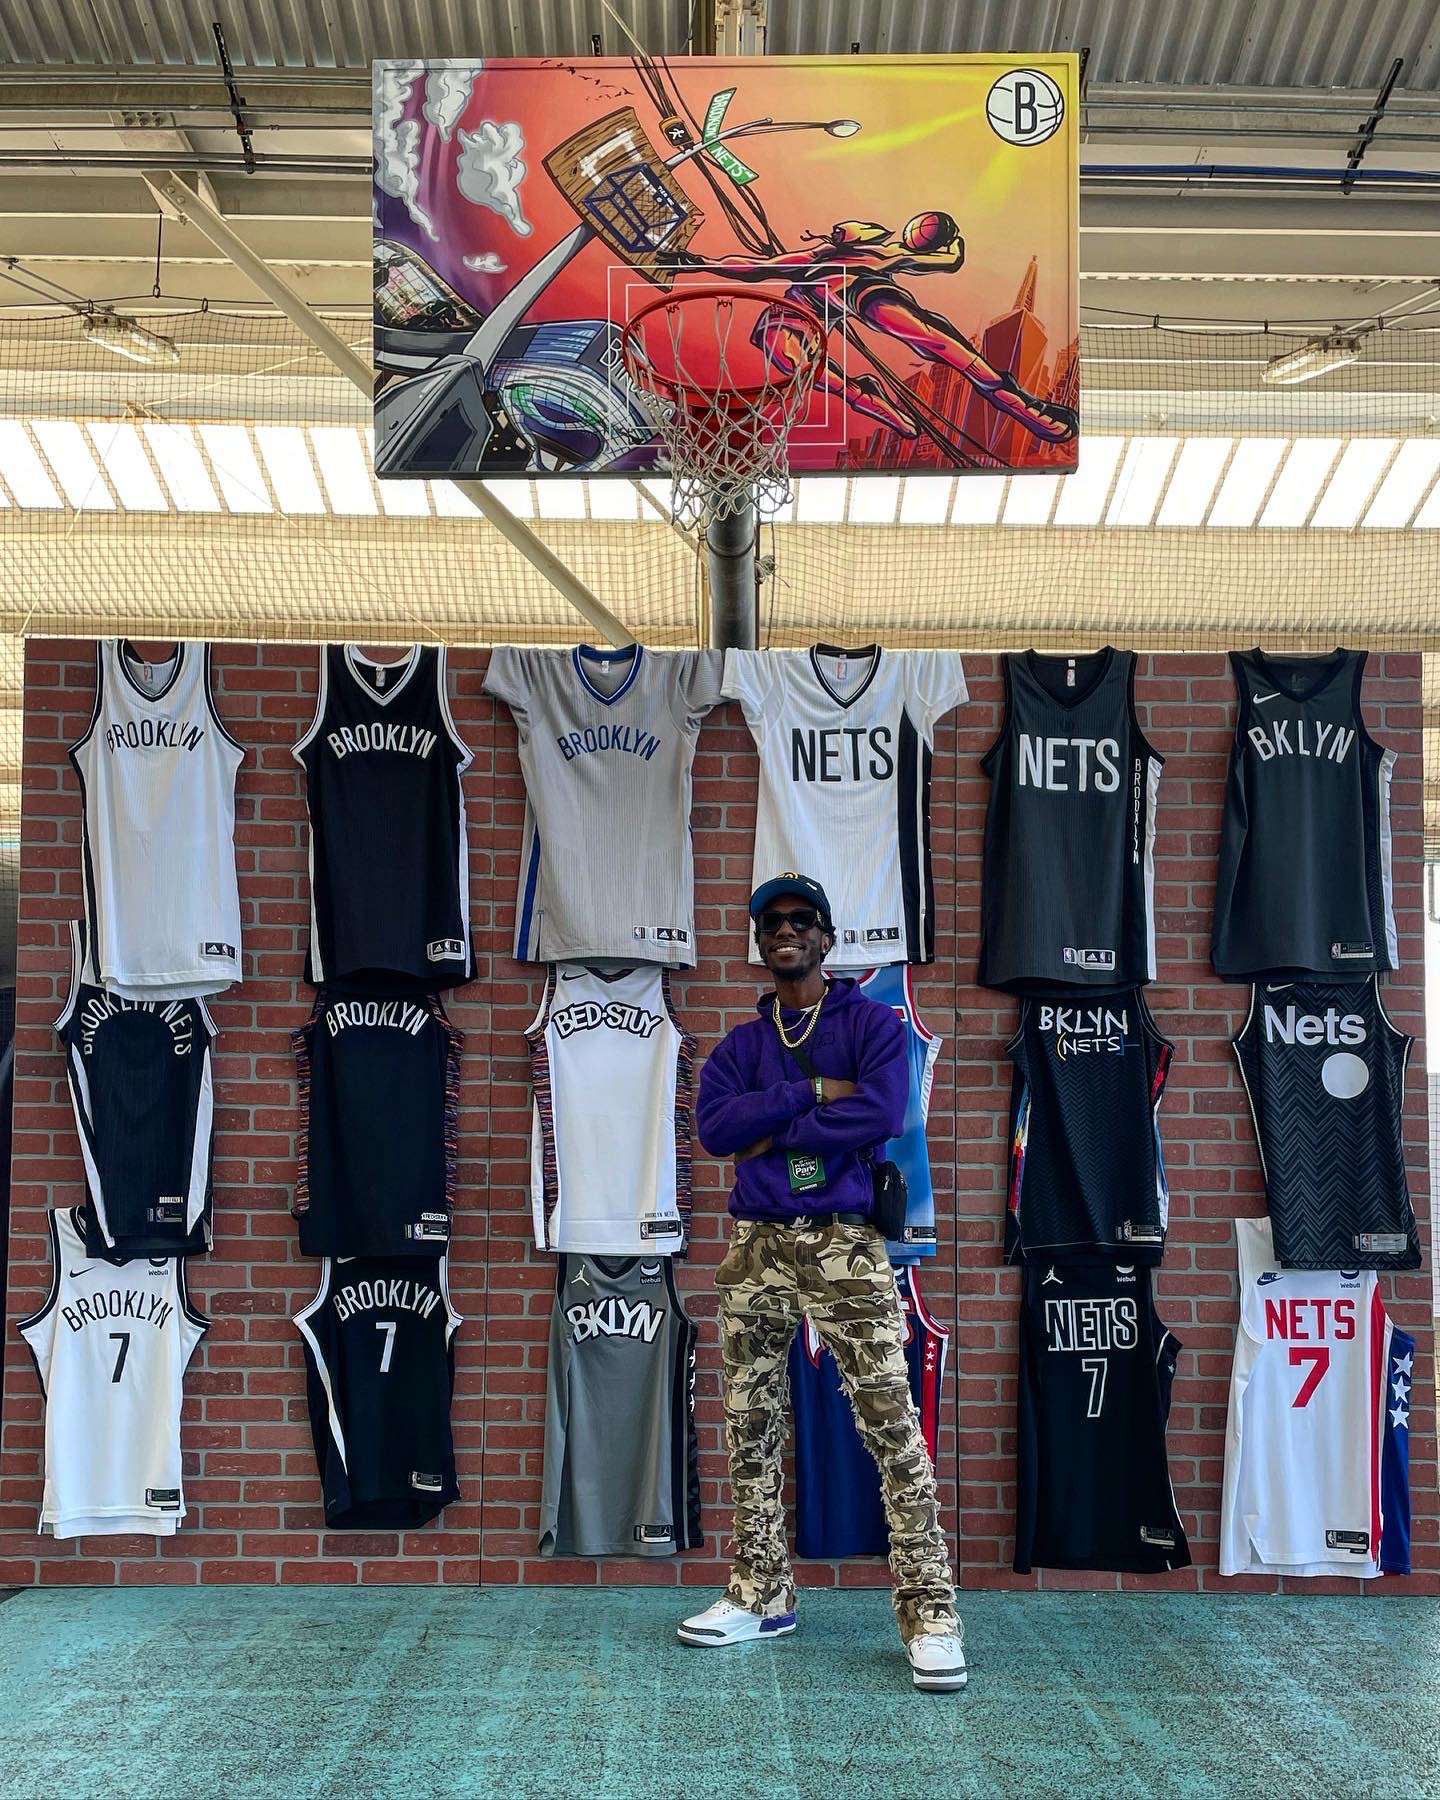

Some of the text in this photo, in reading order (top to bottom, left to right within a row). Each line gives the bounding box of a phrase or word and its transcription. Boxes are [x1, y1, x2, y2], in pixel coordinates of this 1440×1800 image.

[1015, 82, 1037, 134] B
[711, 146, 745, 177] NETS
[106, 719, 204, 753] BROOKLYN
[326, 723, 438, 760] BROOKLYN
[557, 724, 661, 762] BROOKLYN
[791, 726, 894, 782] NETS
[1247, 719, 1356, 764] BKLYN
[1018, 734, 1120, 792] NETS
[159, 999, 193, 1056] NETS
[326, 1001, 430, 1037] BROOKLYN
[1038, 1006, 1128, 1035] BKLYN
[1263, 1005, 1367, 1045] Nets
[795, 1164, 816, 1176] Park
[61, 1289, 173, 1332] BROOKLYN
[332, 1279, 441, 1321] BROOKLYN
[566, 1297, 667, 1346] BKLYN
[1265, 1298, 1356, 1341] NETS
[1045, 1297, 1137, 1352] NETS
[109, 1332, 131, 1384] 7
[375, 1321, 397, 1373] 7
[1082, 1357, 1108, 1418] 7
[1288, 1346, 1331, 1408] 7
